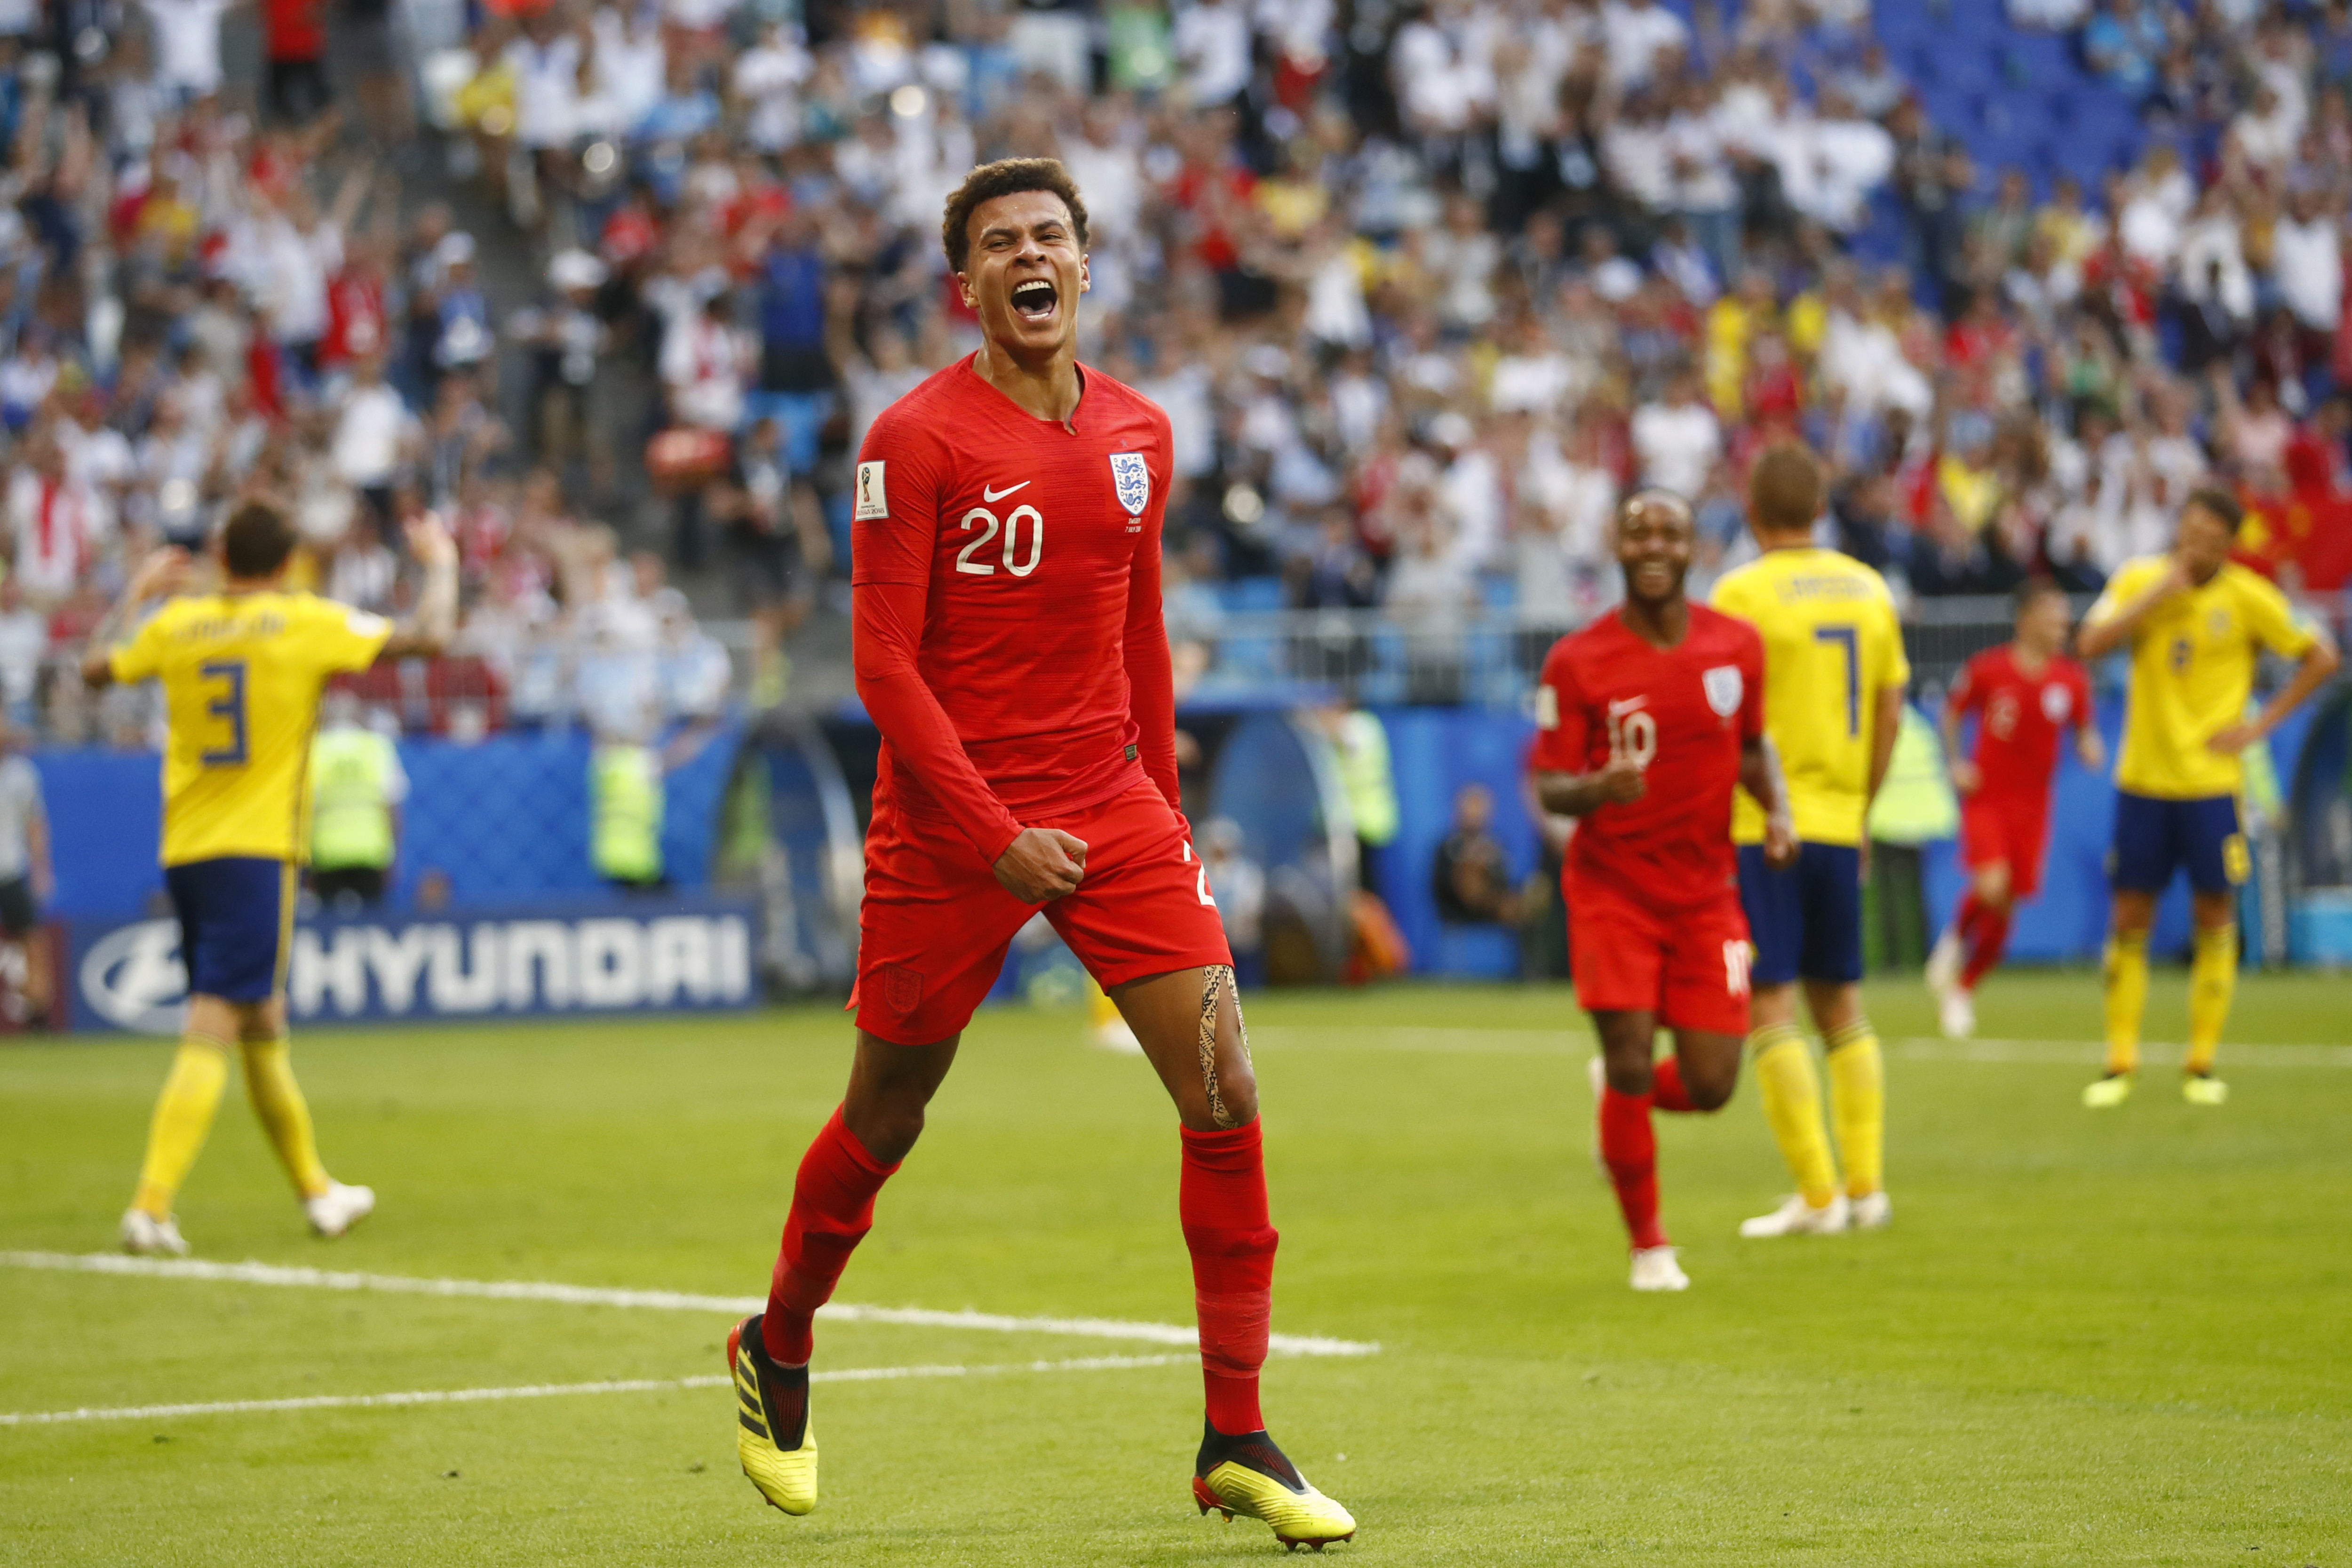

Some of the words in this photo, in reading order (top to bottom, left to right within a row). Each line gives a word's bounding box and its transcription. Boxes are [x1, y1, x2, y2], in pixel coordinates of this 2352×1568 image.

[956, 504, 1043, 577] 20
[200, 660, 247, 766] 3
[1814, 627, 1860, 737] 7
[1605, 711, 1657, 772] 10
[290, 915, 751, 1015] HYUNDAI
